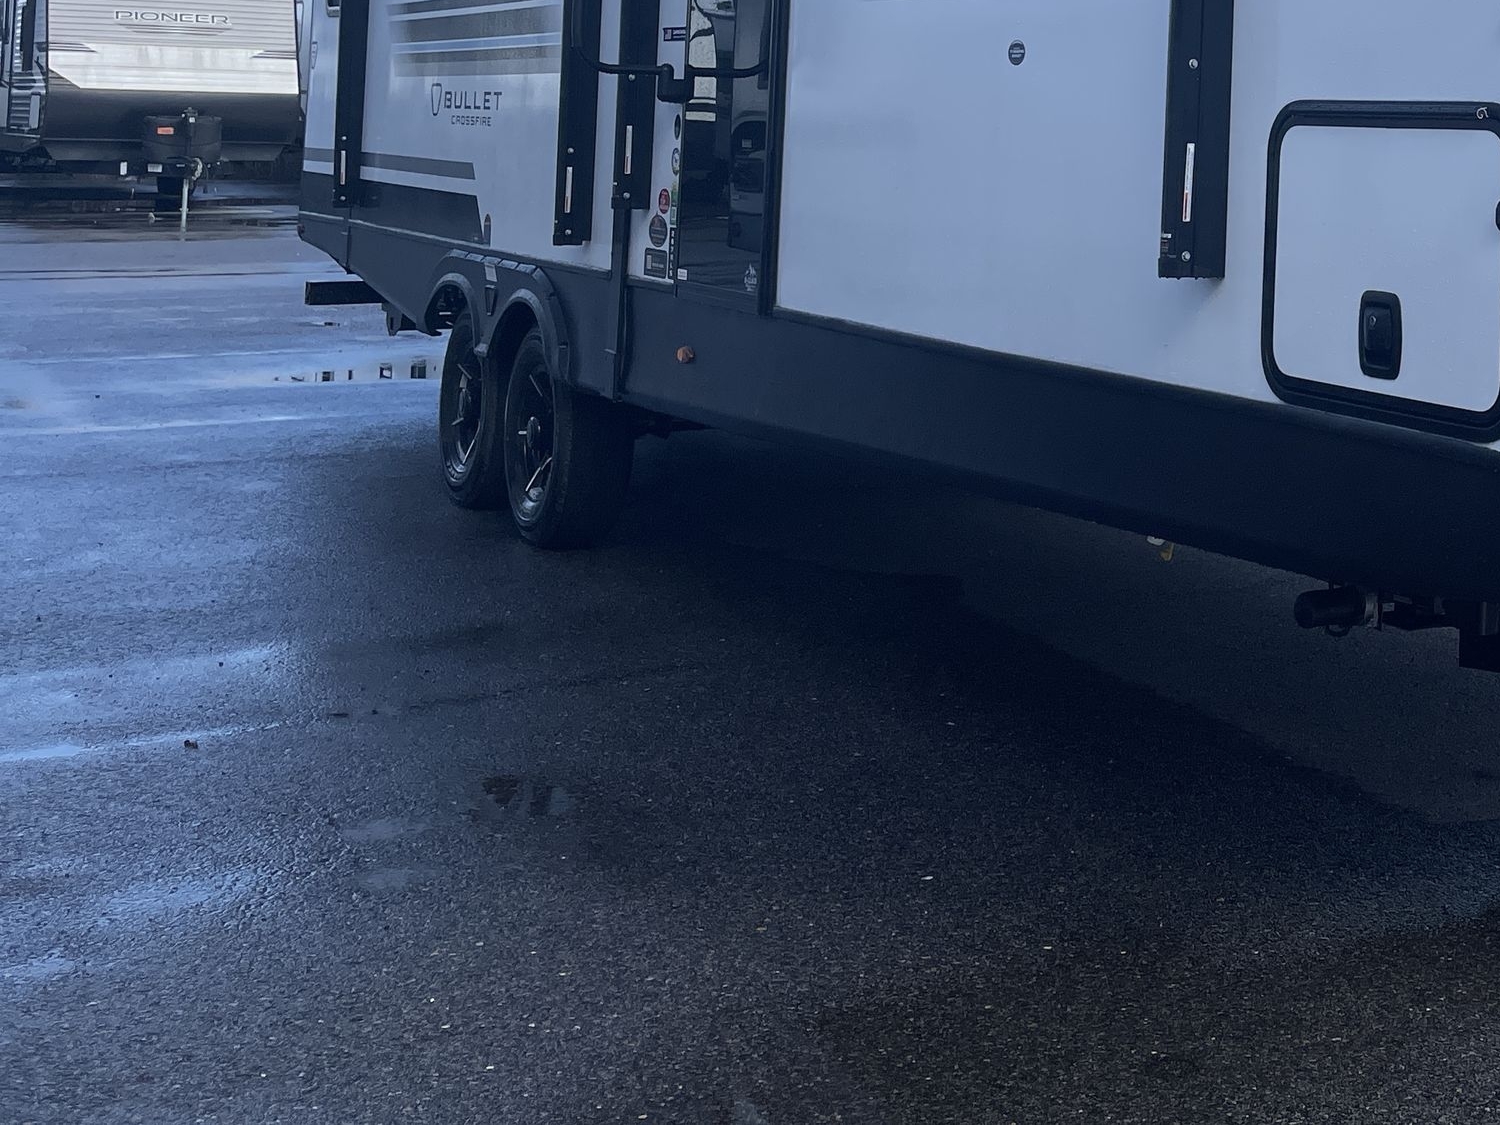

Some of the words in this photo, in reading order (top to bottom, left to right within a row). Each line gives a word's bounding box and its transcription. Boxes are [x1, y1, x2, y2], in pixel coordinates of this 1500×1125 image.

[115, 10, 229, 24] PIONEER
[444, 90, 502, 111] BULLET
[451, 115, 492, 127] CROSSFIRE
